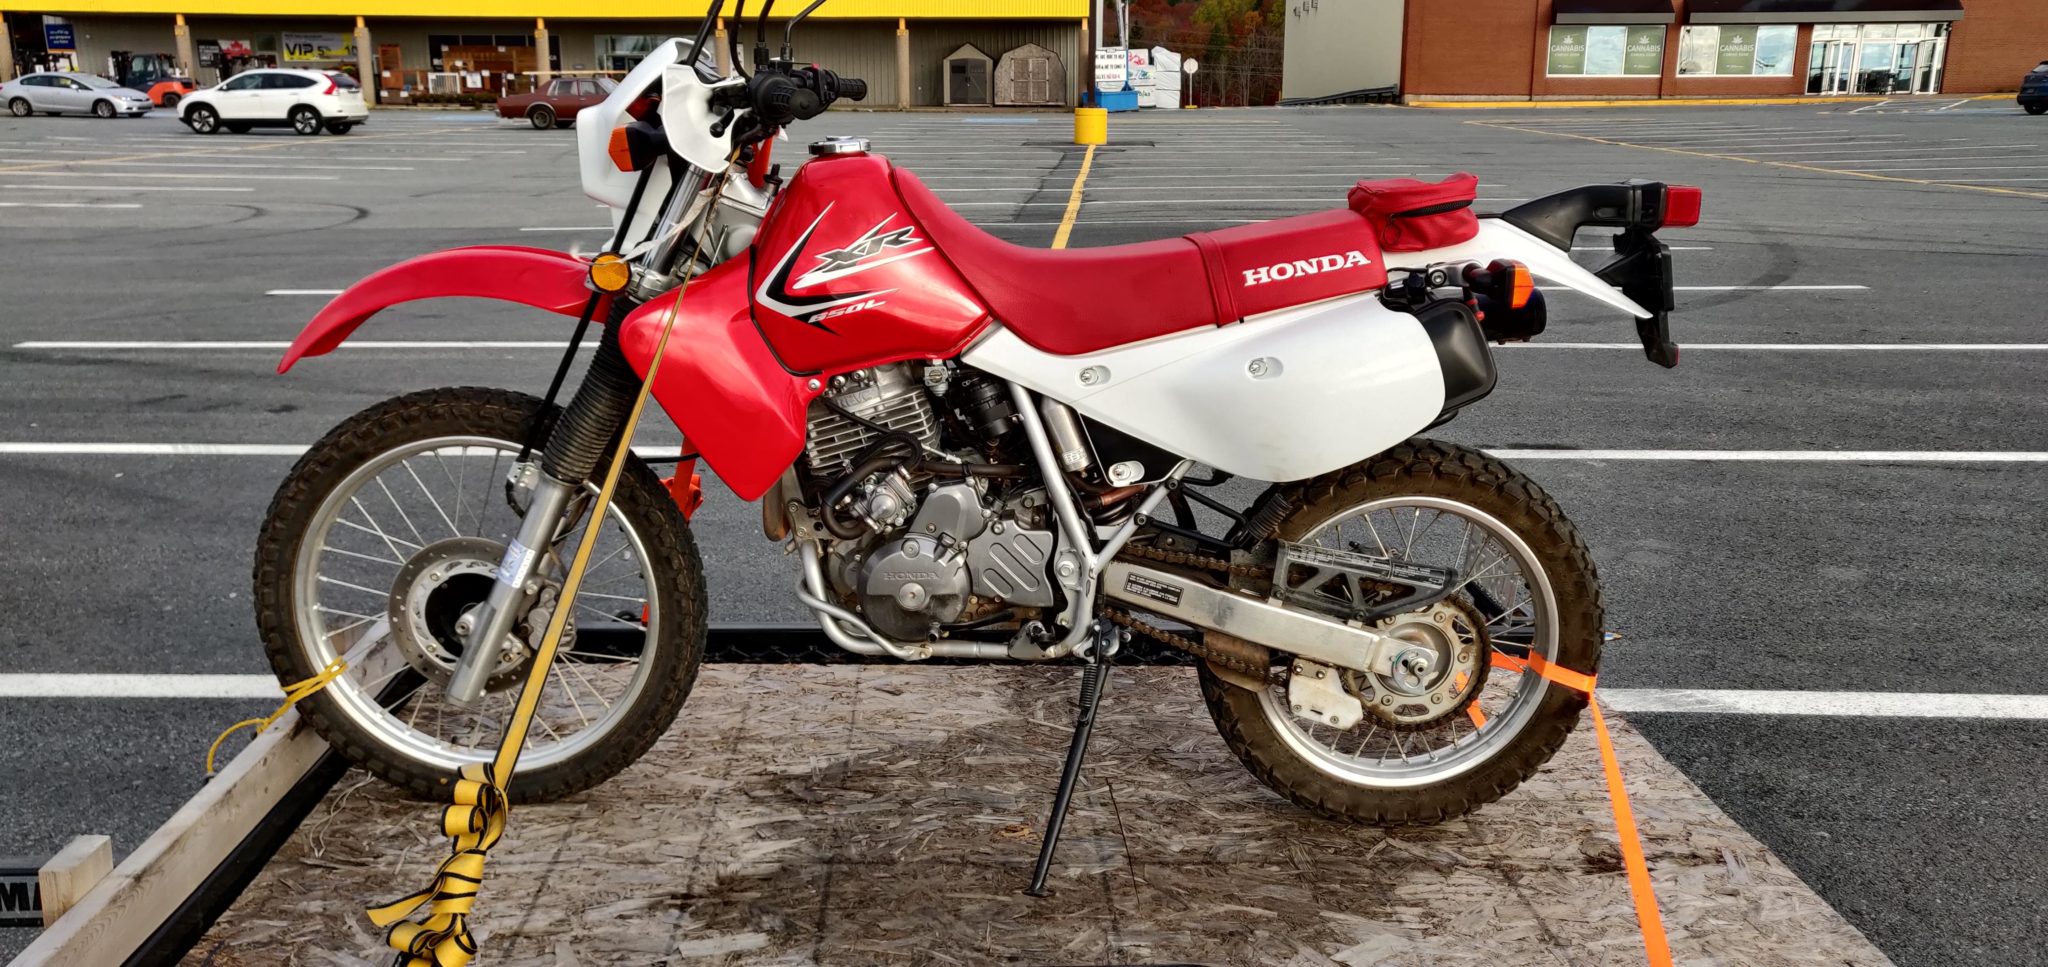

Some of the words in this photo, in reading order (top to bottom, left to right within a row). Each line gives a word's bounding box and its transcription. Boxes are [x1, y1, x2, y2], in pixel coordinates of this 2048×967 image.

[285, 43, 313, 56] VIP
[1551, 44, 1585, 52] CANNABIS
[1627, 44, 1661, 52] CANNABIS
[1720, 44, 1754, 52] CANNABIS
[797, 222, 924, 280] XR
[1242, 250, 1371, 287] HONDA
[882, 571, 941, 581] HONDA
